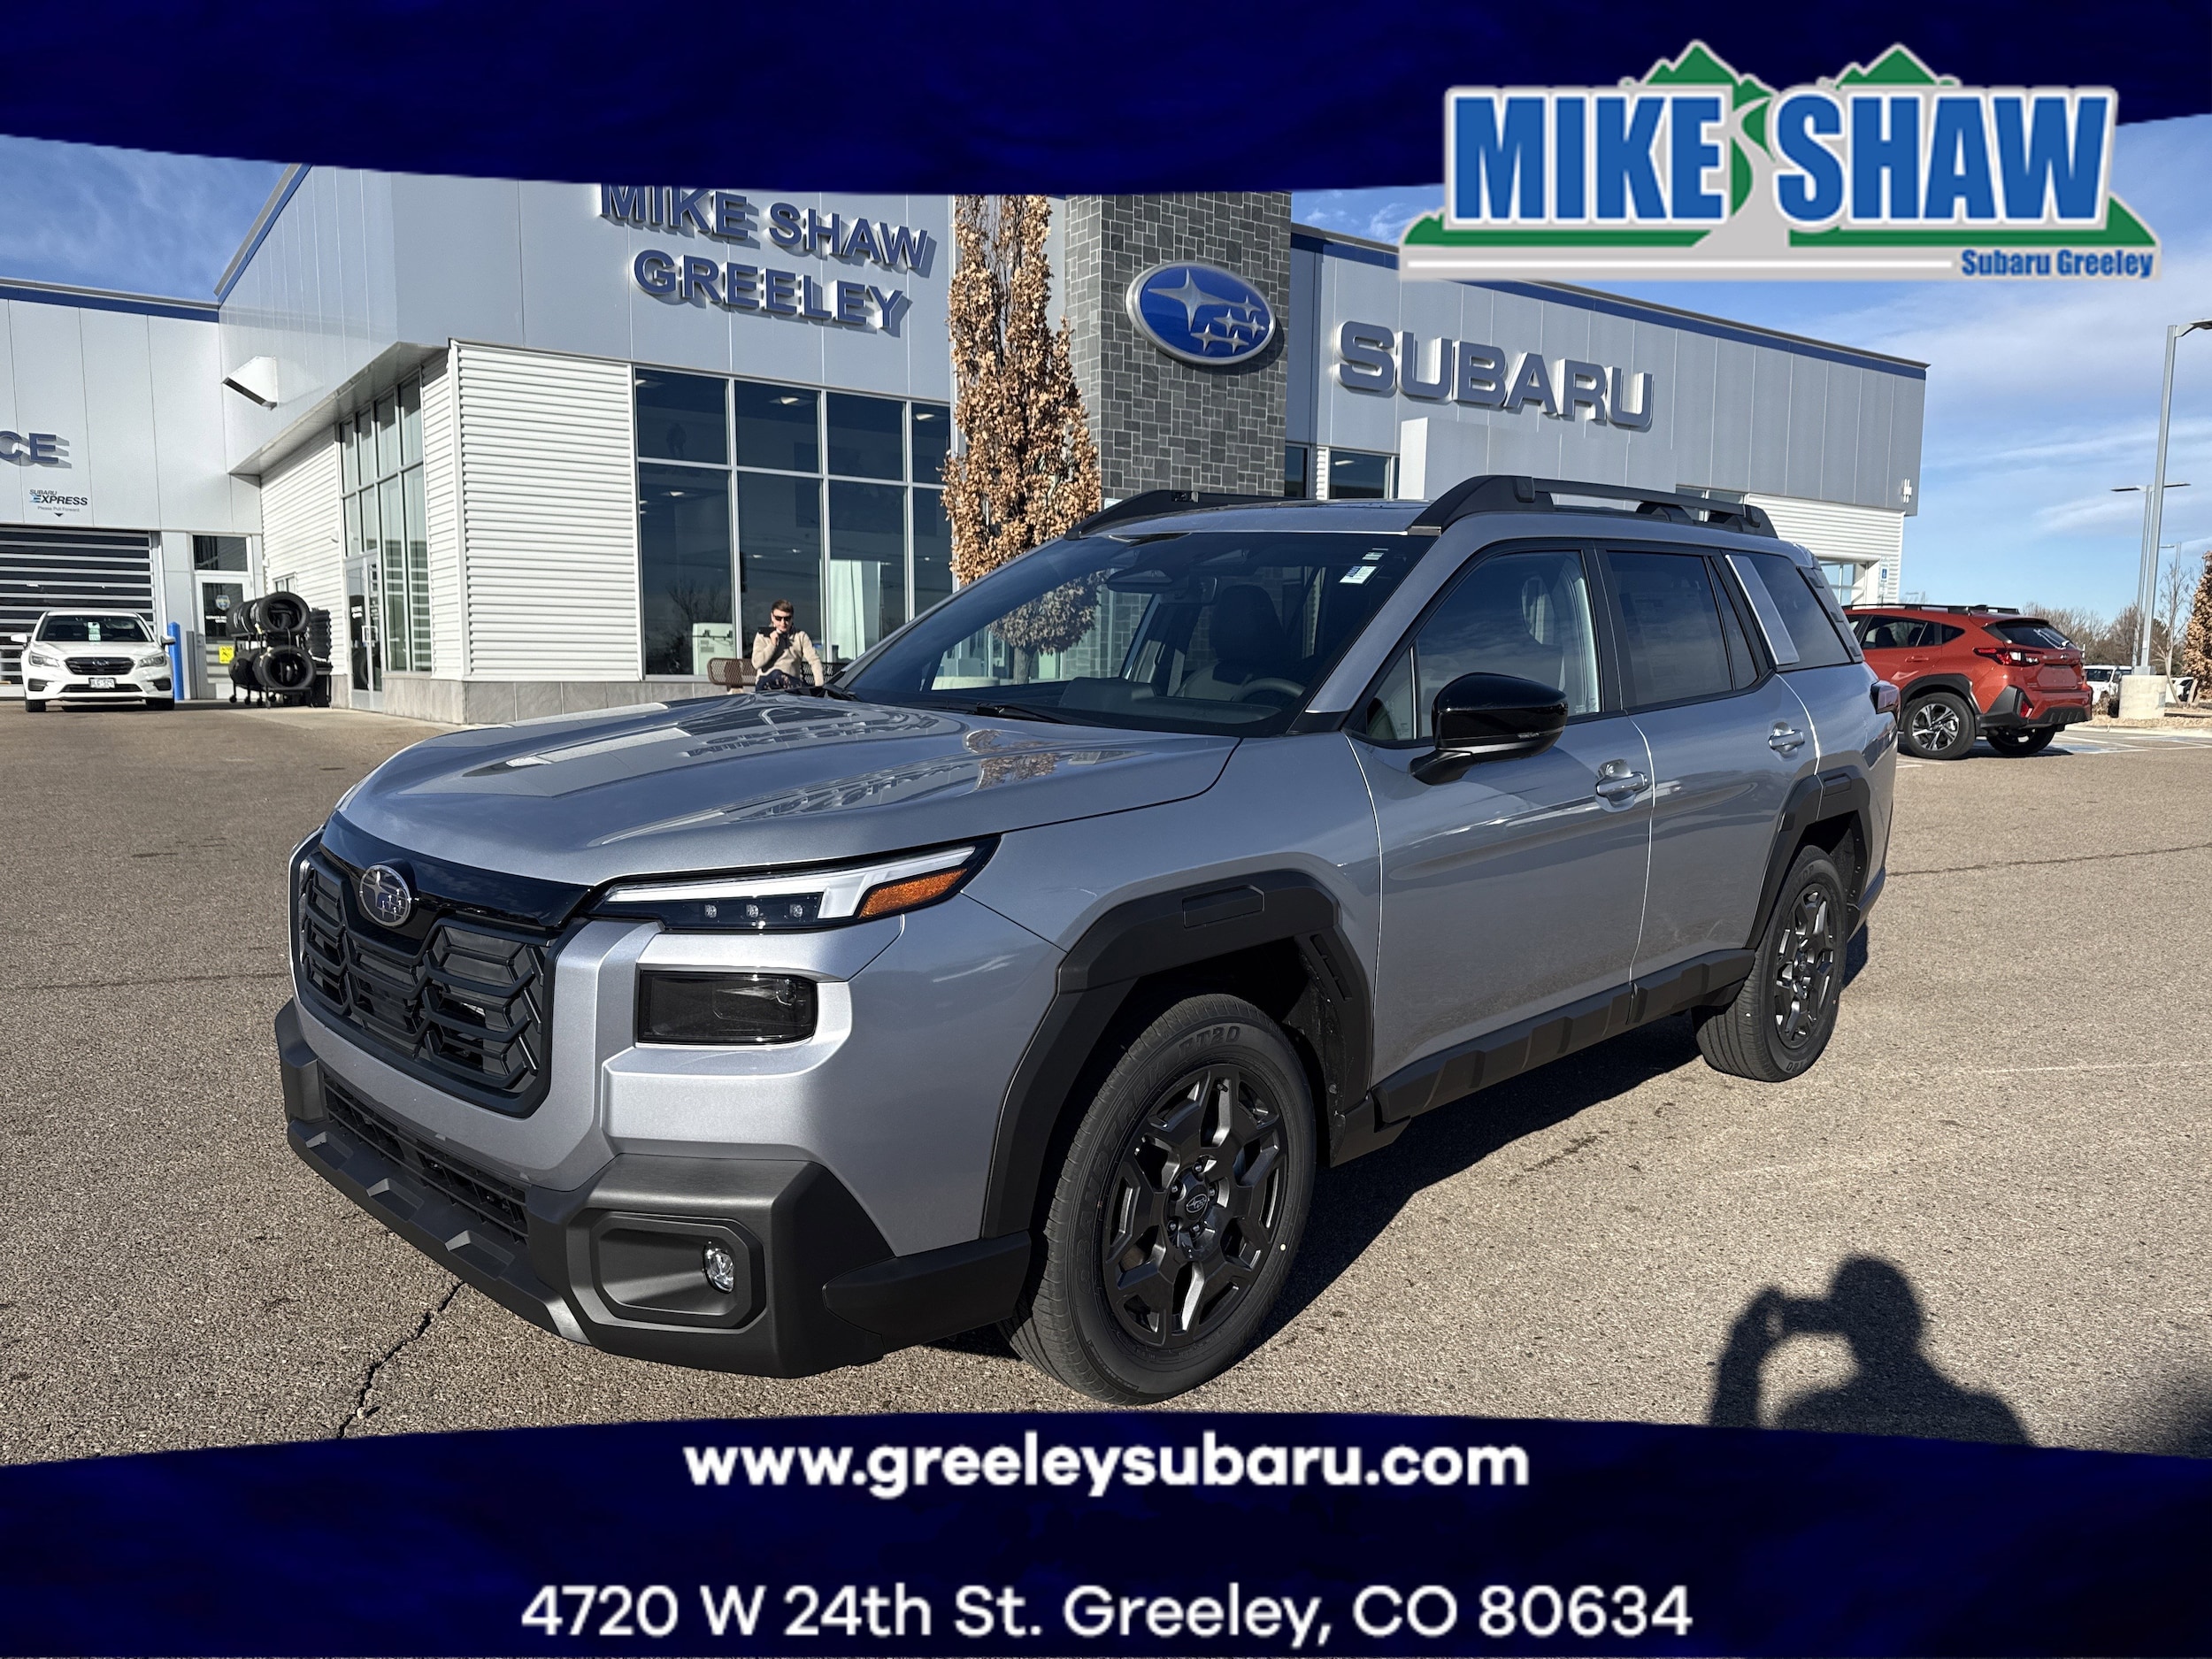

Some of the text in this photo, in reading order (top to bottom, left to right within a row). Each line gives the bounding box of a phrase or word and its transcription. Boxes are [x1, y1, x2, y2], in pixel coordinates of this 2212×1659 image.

[599, 183, 930, 270] MIKE SHAW
[633, 249, 904, 329] GREELEY
[1337, 320, 1655, 427] SUBARU
[32, 495, 88, 505] EXPRESS
